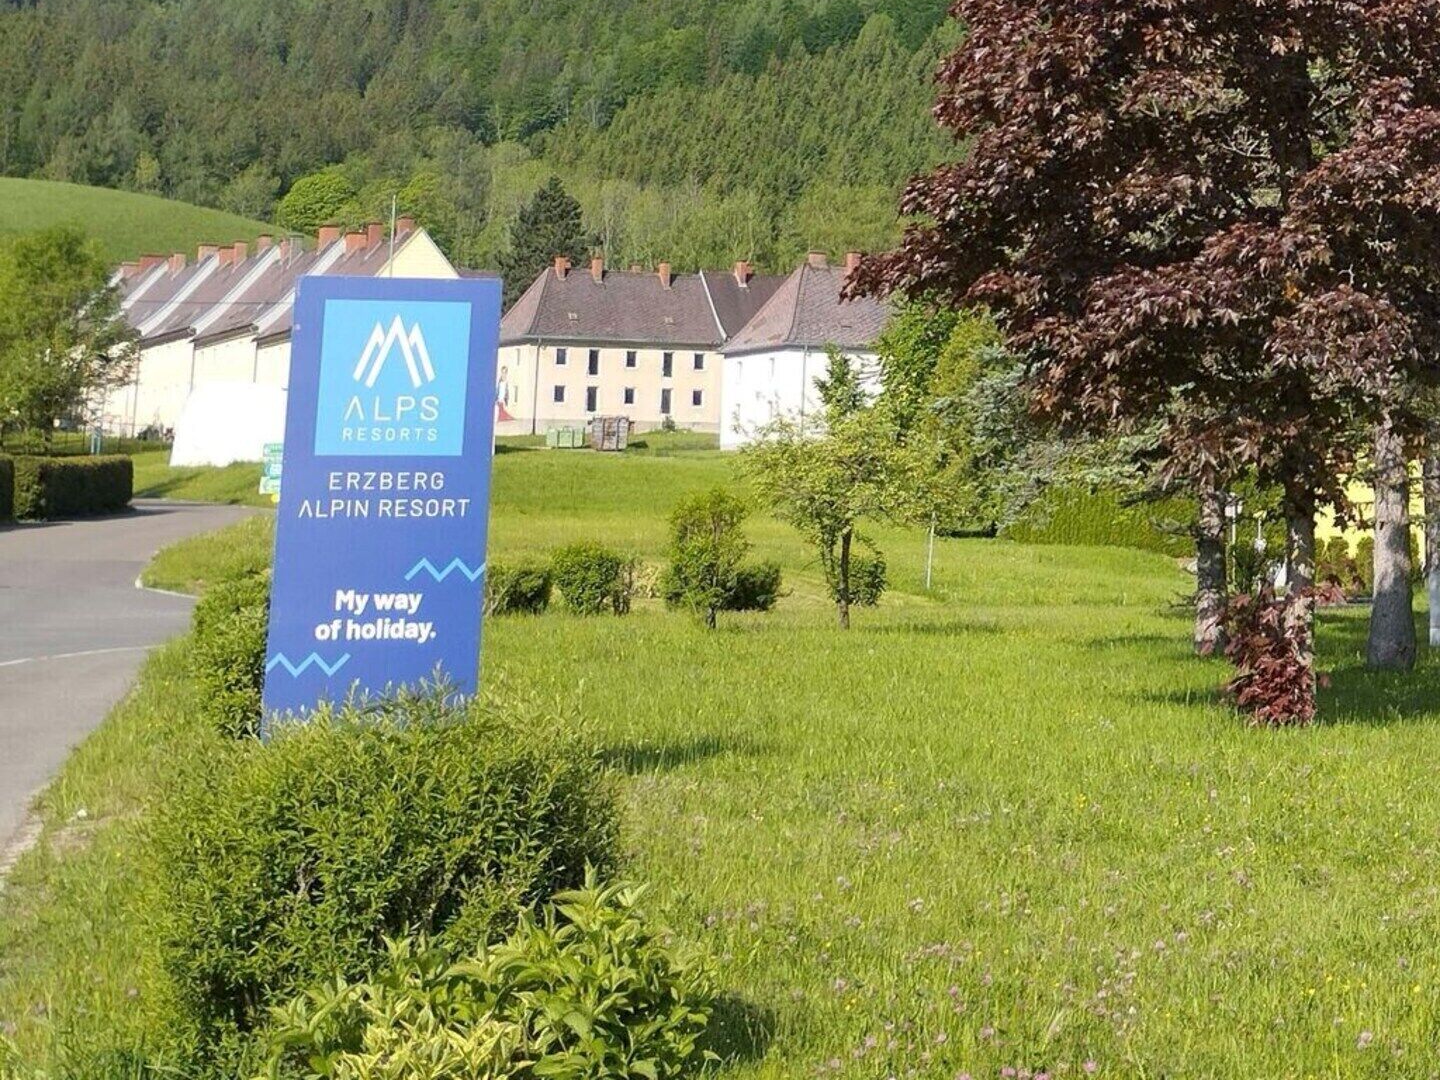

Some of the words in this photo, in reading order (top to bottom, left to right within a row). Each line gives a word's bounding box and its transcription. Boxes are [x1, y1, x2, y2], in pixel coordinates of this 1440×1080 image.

[344, 395, 439, 421] ALPS
[342, 427, 437, 441] RESORTS
[329, 471, 445, 491] ERZBERG
[298, 499, 369, 518] ALPIN
[378, 498, 470, 518] RESORT
[335, 589, 369, 615] My
[373, 593, 423, 614] way
[314, 618, 342, 641] of
[346, 617, 436, 643] holiday.
